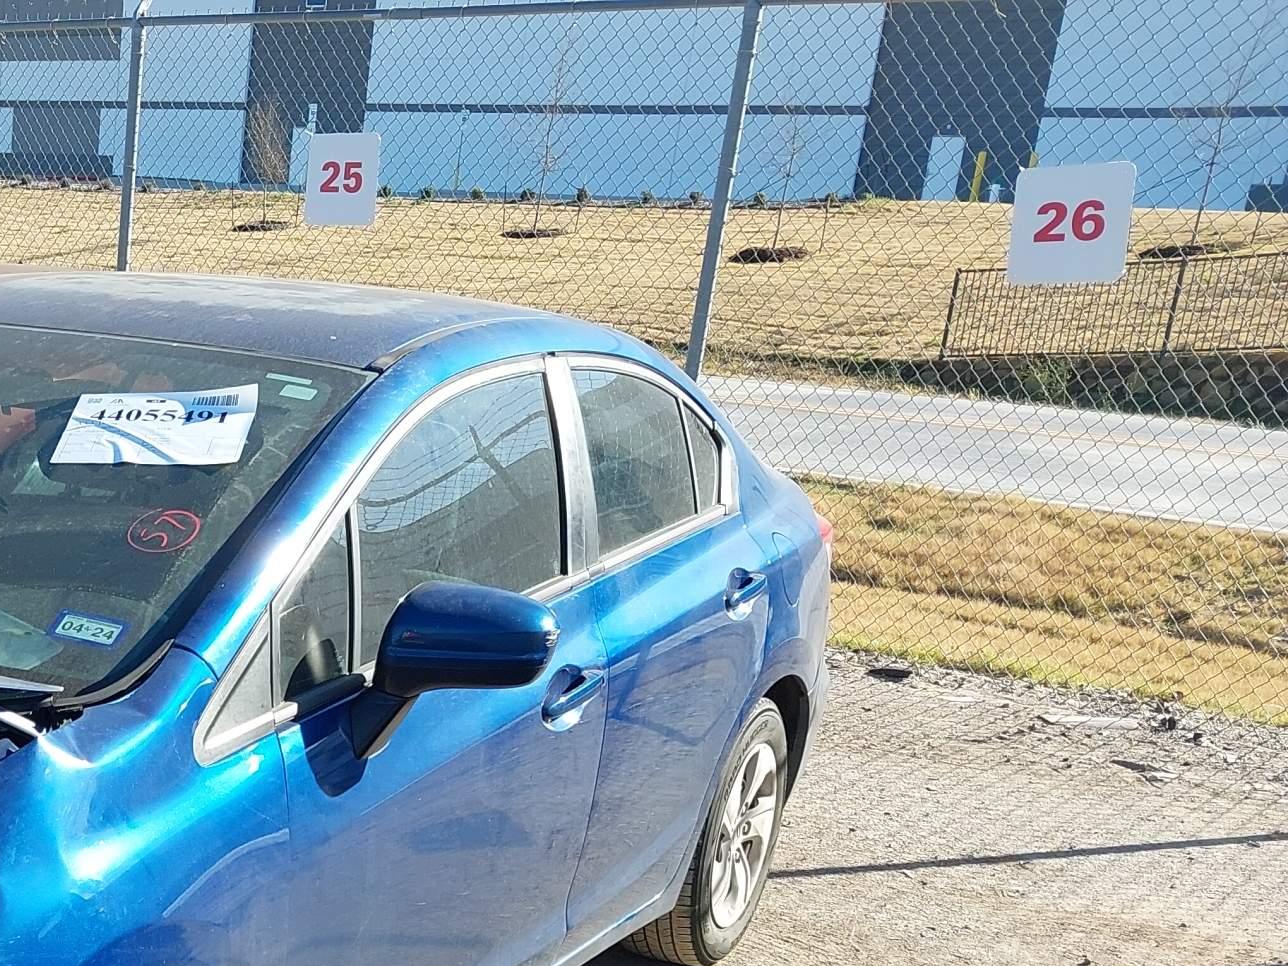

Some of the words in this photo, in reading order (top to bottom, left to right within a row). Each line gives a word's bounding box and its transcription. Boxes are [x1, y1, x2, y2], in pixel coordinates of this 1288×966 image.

[320, 161, 363, 193] 25
[1033, 200, 1105, 242] 26
[90, 408, 229, 424] 44055491
